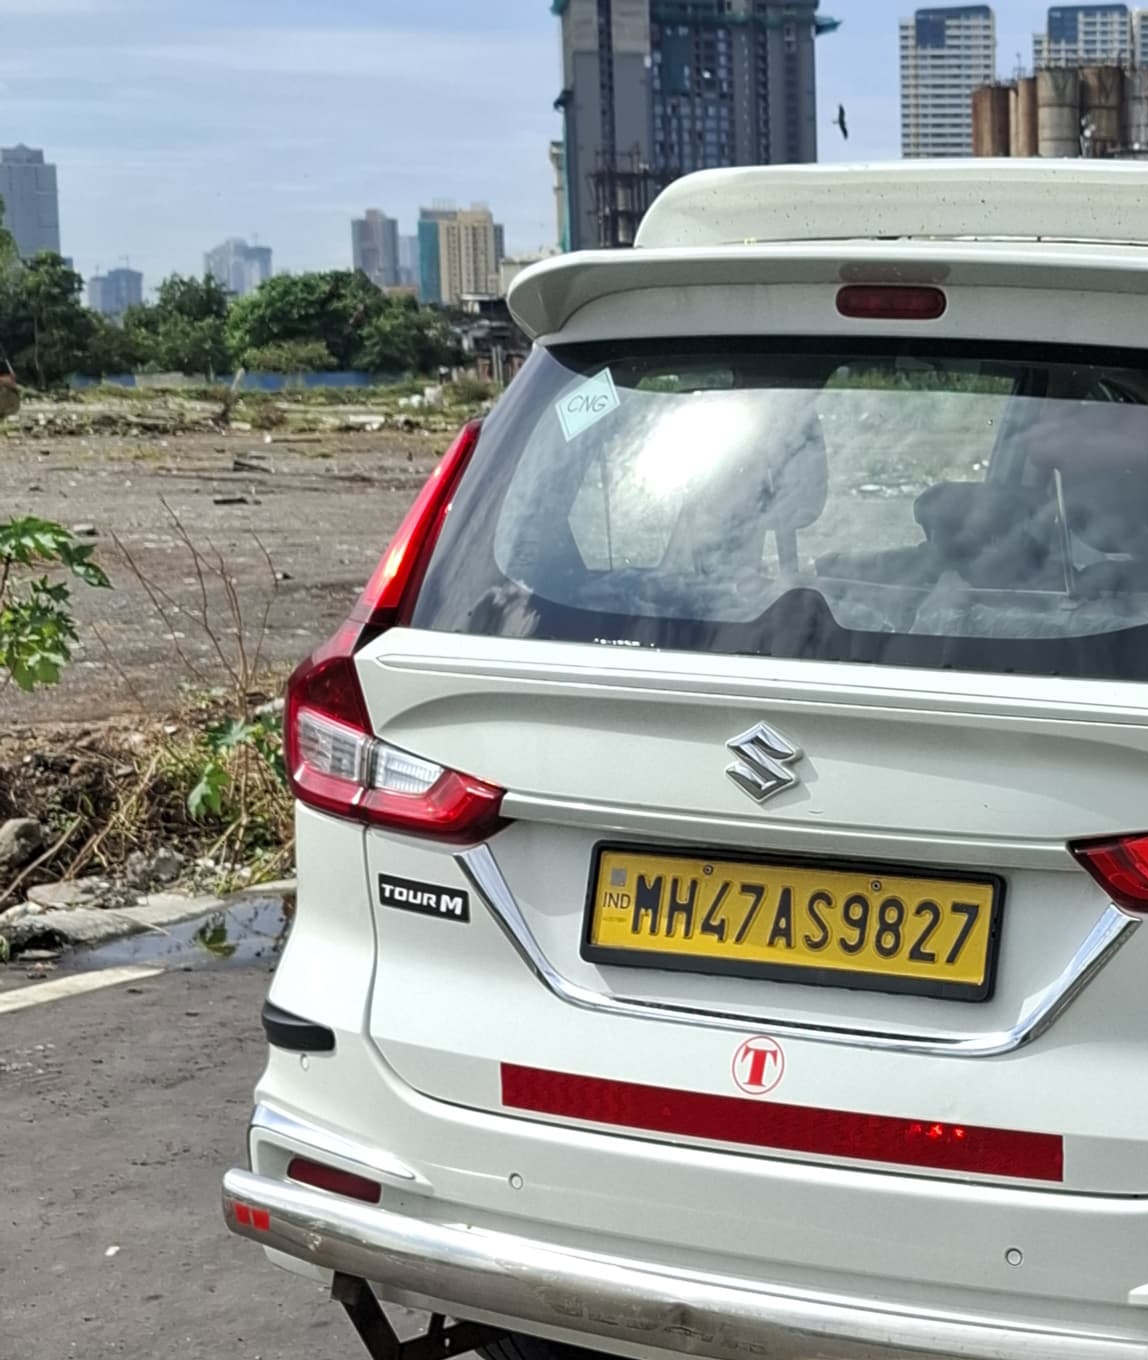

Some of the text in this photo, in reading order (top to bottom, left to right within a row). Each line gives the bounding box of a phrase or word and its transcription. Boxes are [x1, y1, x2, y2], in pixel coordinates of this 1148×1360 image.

[567, 394, 609, 413] CNG
[380, 883, 463, 915] TOUR M
[602, 890, 632, 910] IND
[630, 873, 981, 965] MH47AS9827
[740, 1042, 778, 1088] T
